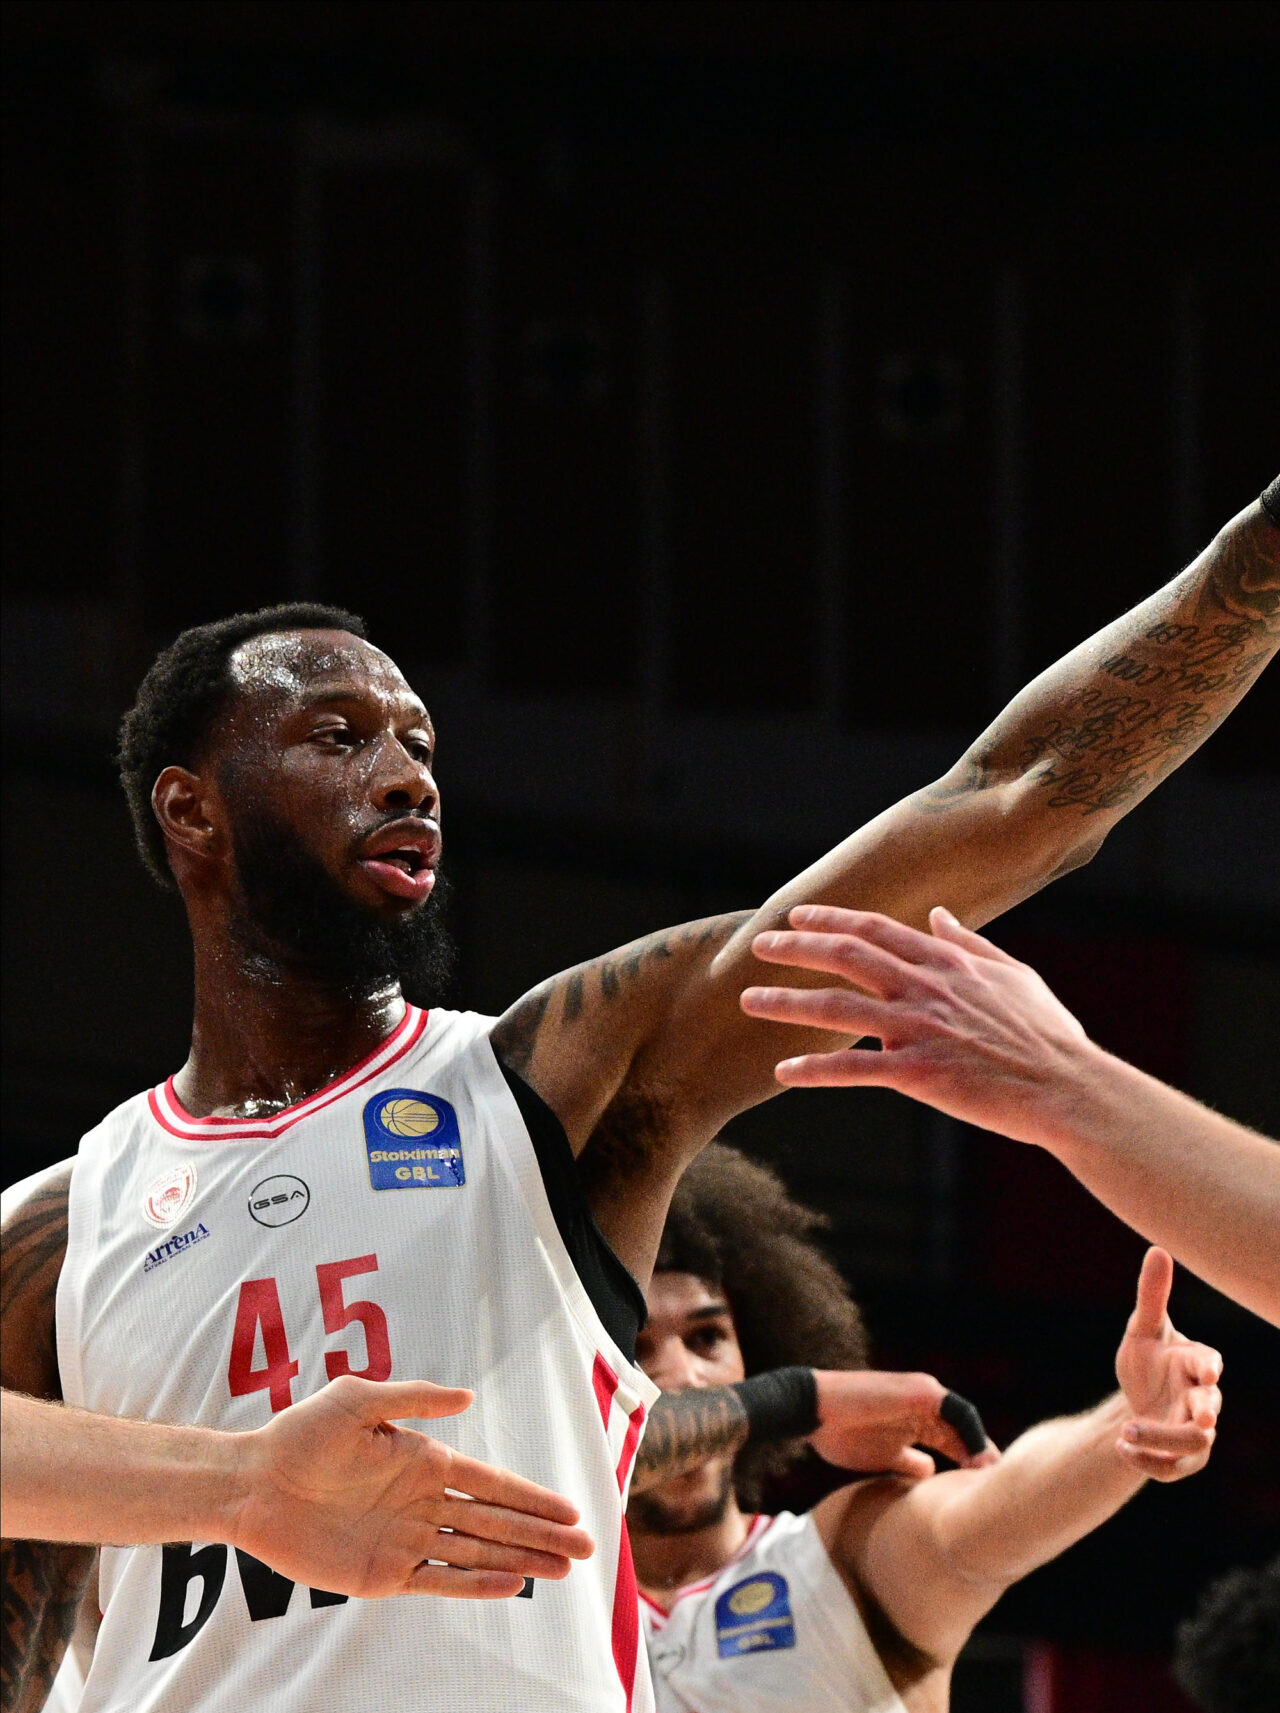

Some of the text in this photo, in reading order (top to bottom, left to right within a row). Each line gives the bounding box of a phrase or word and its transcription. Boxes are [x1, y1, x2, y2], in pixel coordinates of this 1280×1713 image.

[369, 1148, 461, 1163] Stoiximan
[394, 1166, 440, 1181] GBL
[252, 1189, 305, 1211] GSA
[228, 1253, 392, 1413] 45
